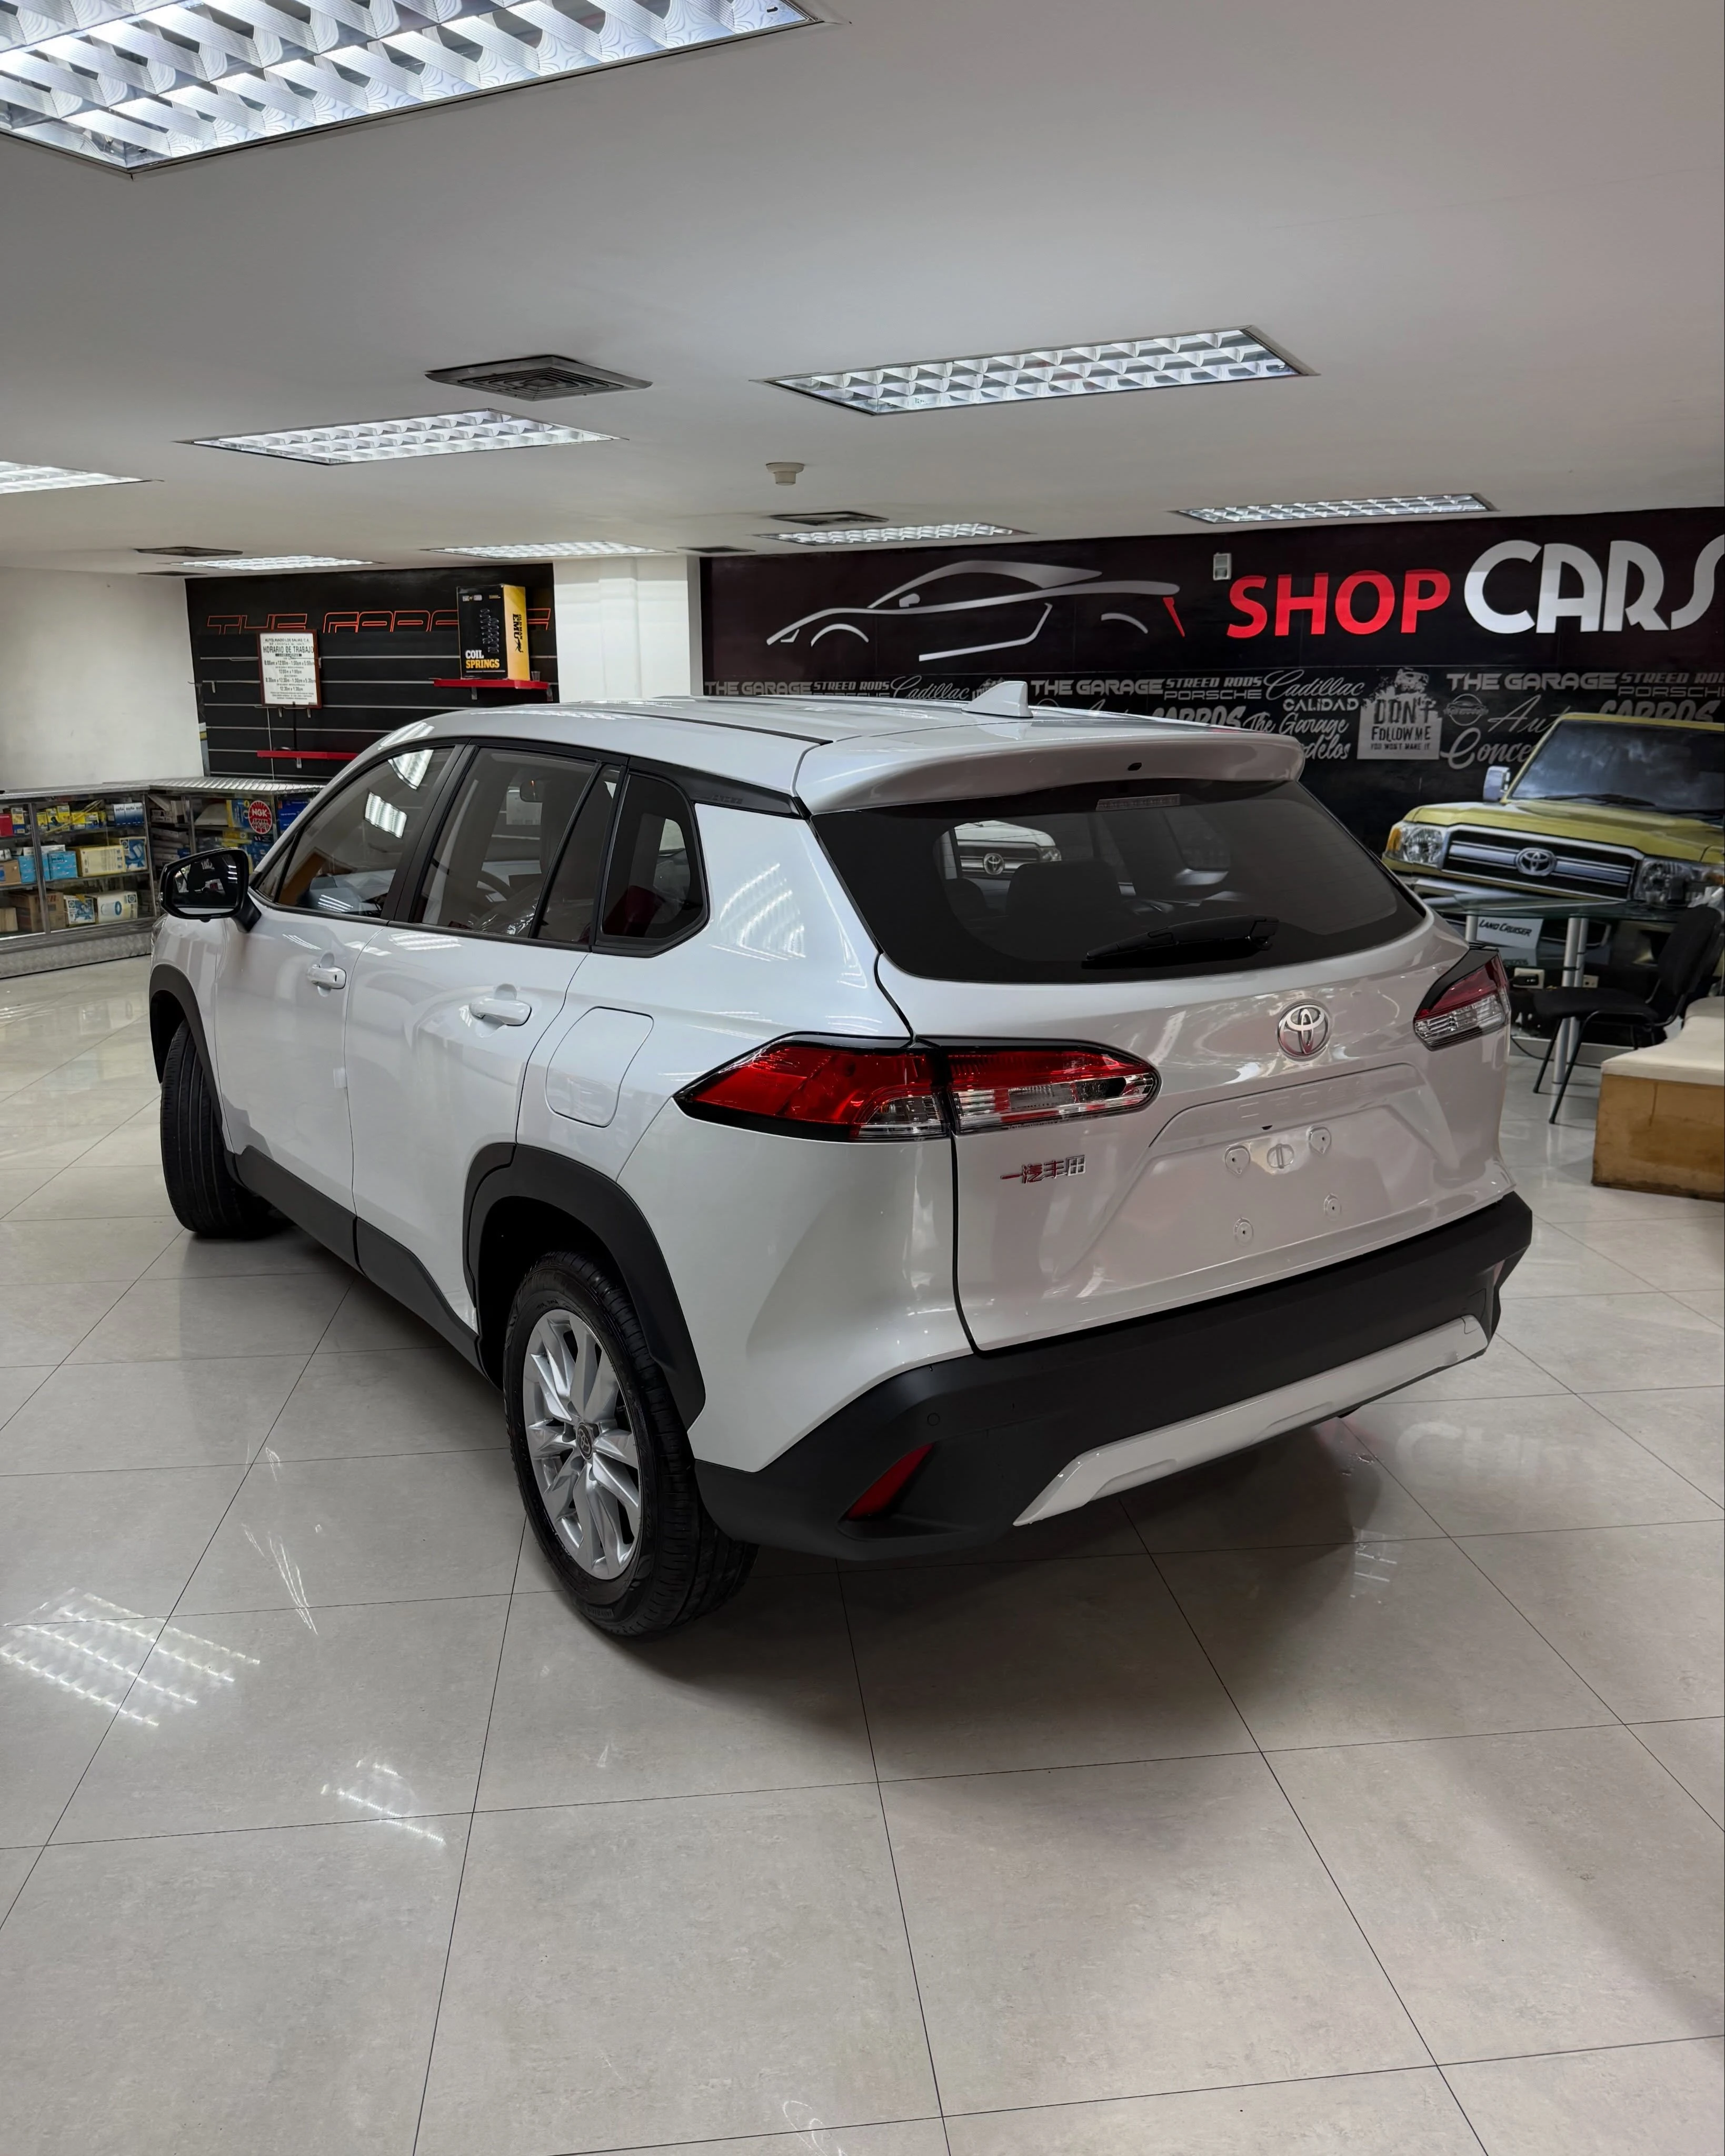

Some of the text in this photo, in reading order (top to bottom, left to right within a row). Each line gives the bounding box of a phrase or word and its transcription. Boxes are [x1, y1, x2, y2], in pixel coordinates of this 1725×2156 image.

[1227, 569, 1451, 638] SHOP
[465, 650, 484, 659] COIL
[466, 659, 500, 669] SPRINGS
[1166, 676, 1263, 688] STREED RODS
[1263, 669, 1365, 701] Cadillac
[1446, 673, 1621, 691] THE GARAGE
[1620, 672, 1689, 683] STREED
[704, 681, 814, 695] THE GARAGE
[813, 681, 891, 691] STREED RODS
[891, 675, 970, 701] Cadillac
[1031, 679, 1165, 696] THE GARAGE
[1618, 686, 1725, 697] PORSCH
[1164, 689, 1262, 701] PORSCHE
[1283, 698, 1360, 712] CALIDAD
[1373, 697, 1434, 724] DON'T
[1242, 712, 1350, 740] The Garage
[1371, 726, 1431, 742] FOLLOW ME
[252, 808, 268, 817] NGK
[1479, 919, 1533, 937] LAND CRUISER
[1000, 1155, 1086, 1184] 一汽丰田
